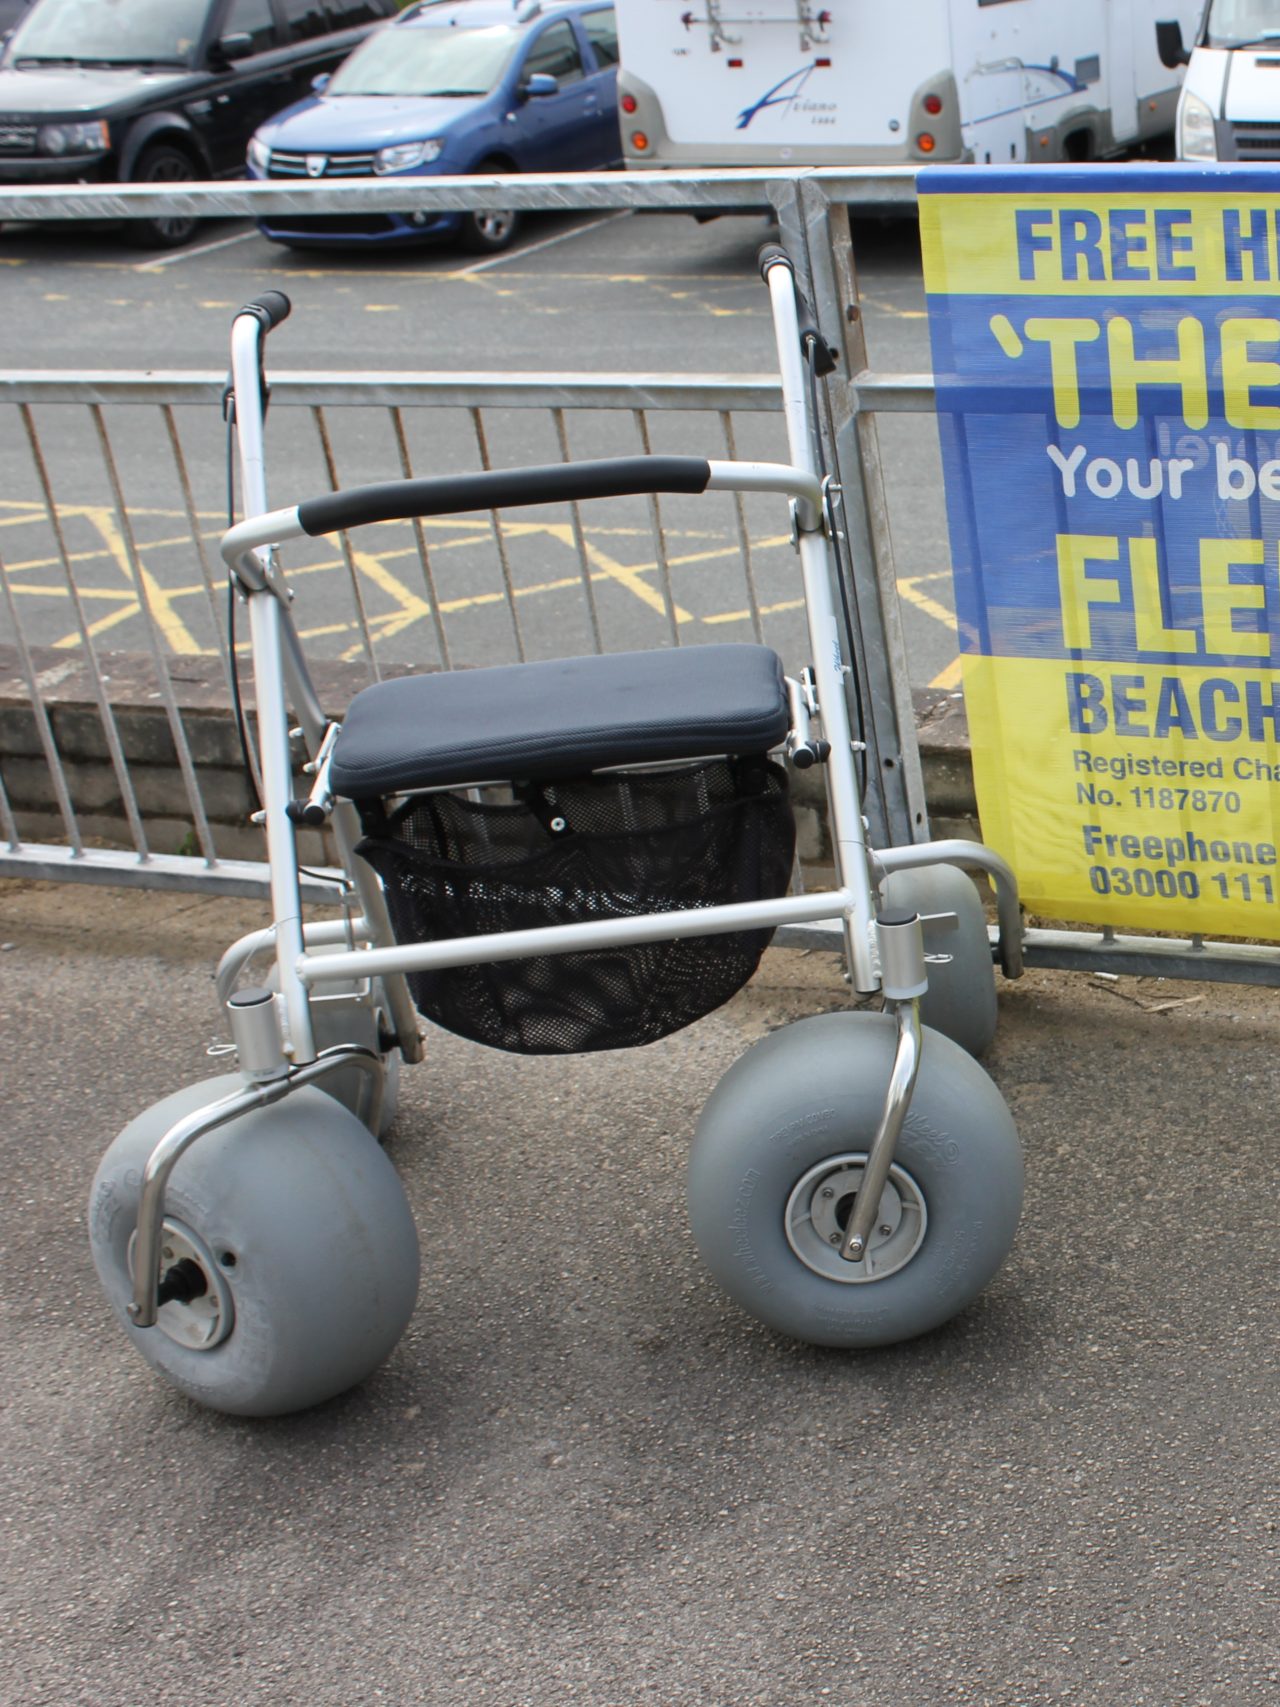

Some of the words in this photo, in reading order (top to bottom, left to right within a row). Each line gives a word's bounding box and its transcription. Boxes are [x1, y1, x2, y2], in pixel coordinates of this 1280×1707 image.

[1014, 208, 1197, 282] FREE
[1046, 444, 1194, 500] Your
[1072, 750, 1224, 780] Registered
[1075, 782, 1122, 807] No.
[1130, 786, 1242, 814] 1187870
[1082, 825, 1277, 867] Freephone
[1089, 866, 1201, 899] 03000
[1211, 873, 1275, 904] 111
